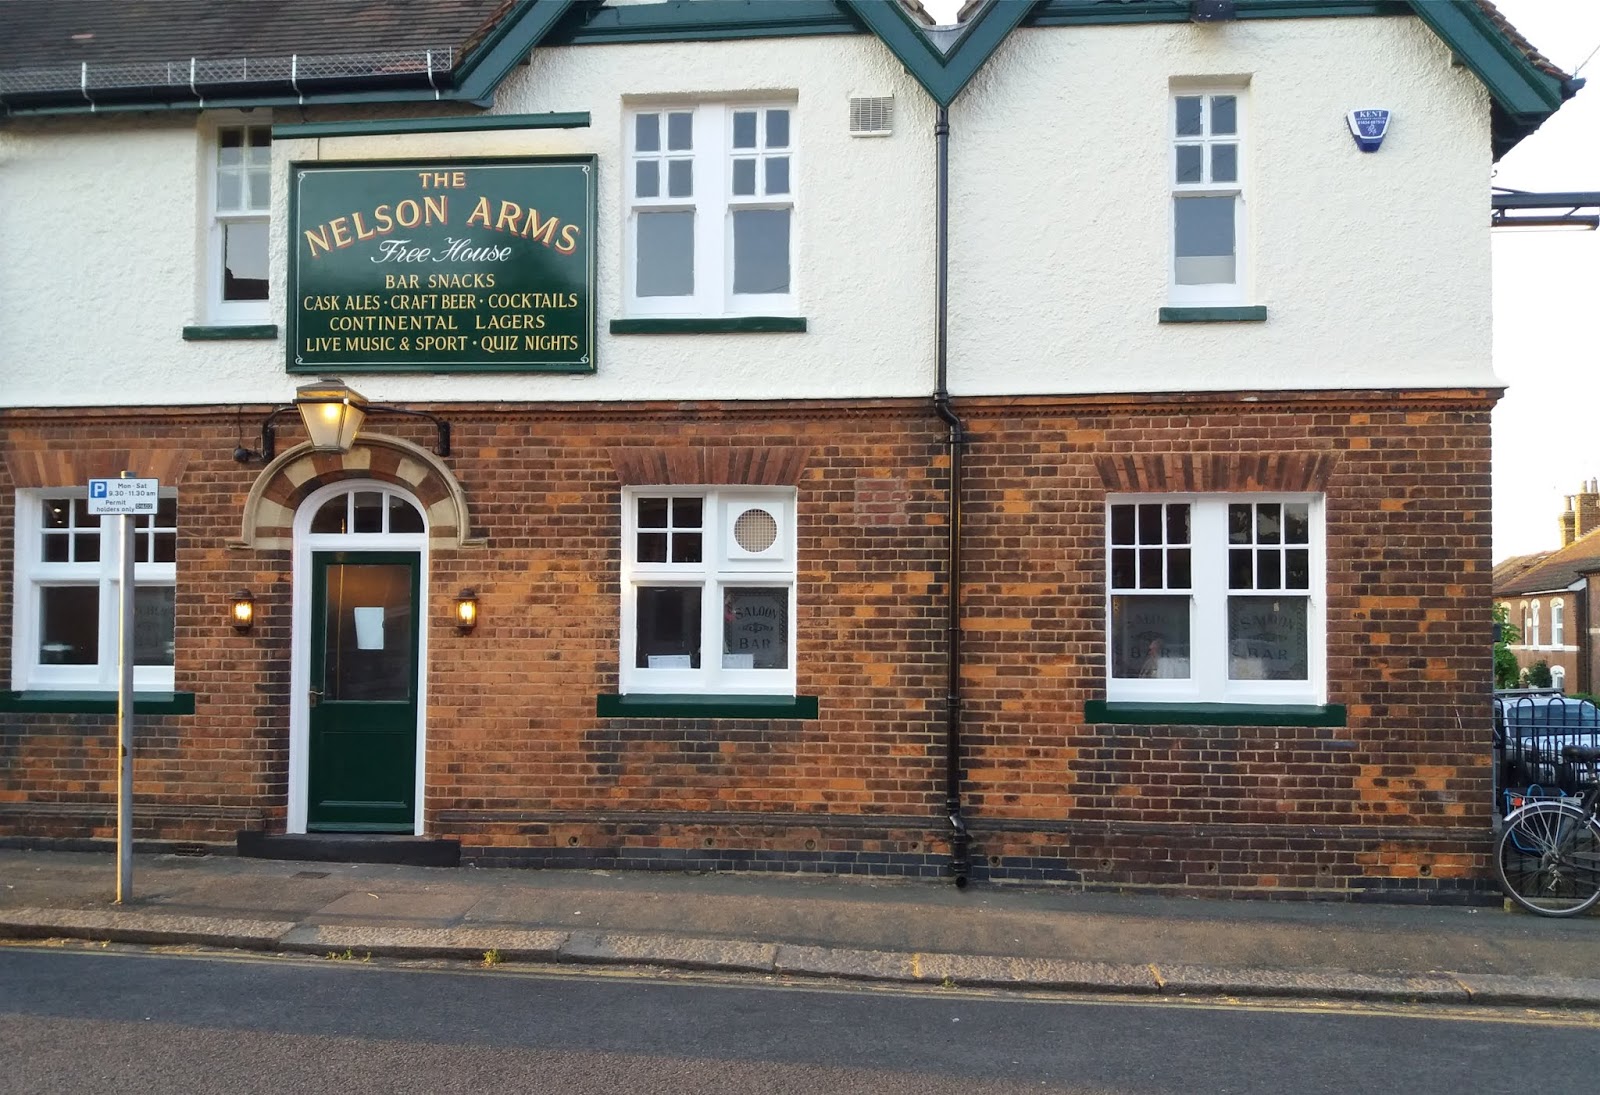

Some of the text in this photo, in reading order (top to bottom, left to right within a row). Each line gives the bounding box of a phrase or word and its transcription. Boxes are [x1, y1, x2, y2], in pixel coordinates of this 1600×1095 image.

[419, 172, 466, 189] THE
[304, 195, 581, 257] NELSON ARMS
[370, 236, 512, 264] Free House
[385, 273, 496, 289] BAR SNACKS
[303, 293, 578, 311] CASK ALES CRAFT BEER COCKTAILS
[329, 314, 546, 331] CONTINENTAL LAGERS
[306, 334, 579, 353] LIVE MUSIC & SPORT QUIZ NIGHTS
[94, 483, 105, 497] P
[735, 605, 777, 620] SALOON
[740, 637, 771, 649] BAR
